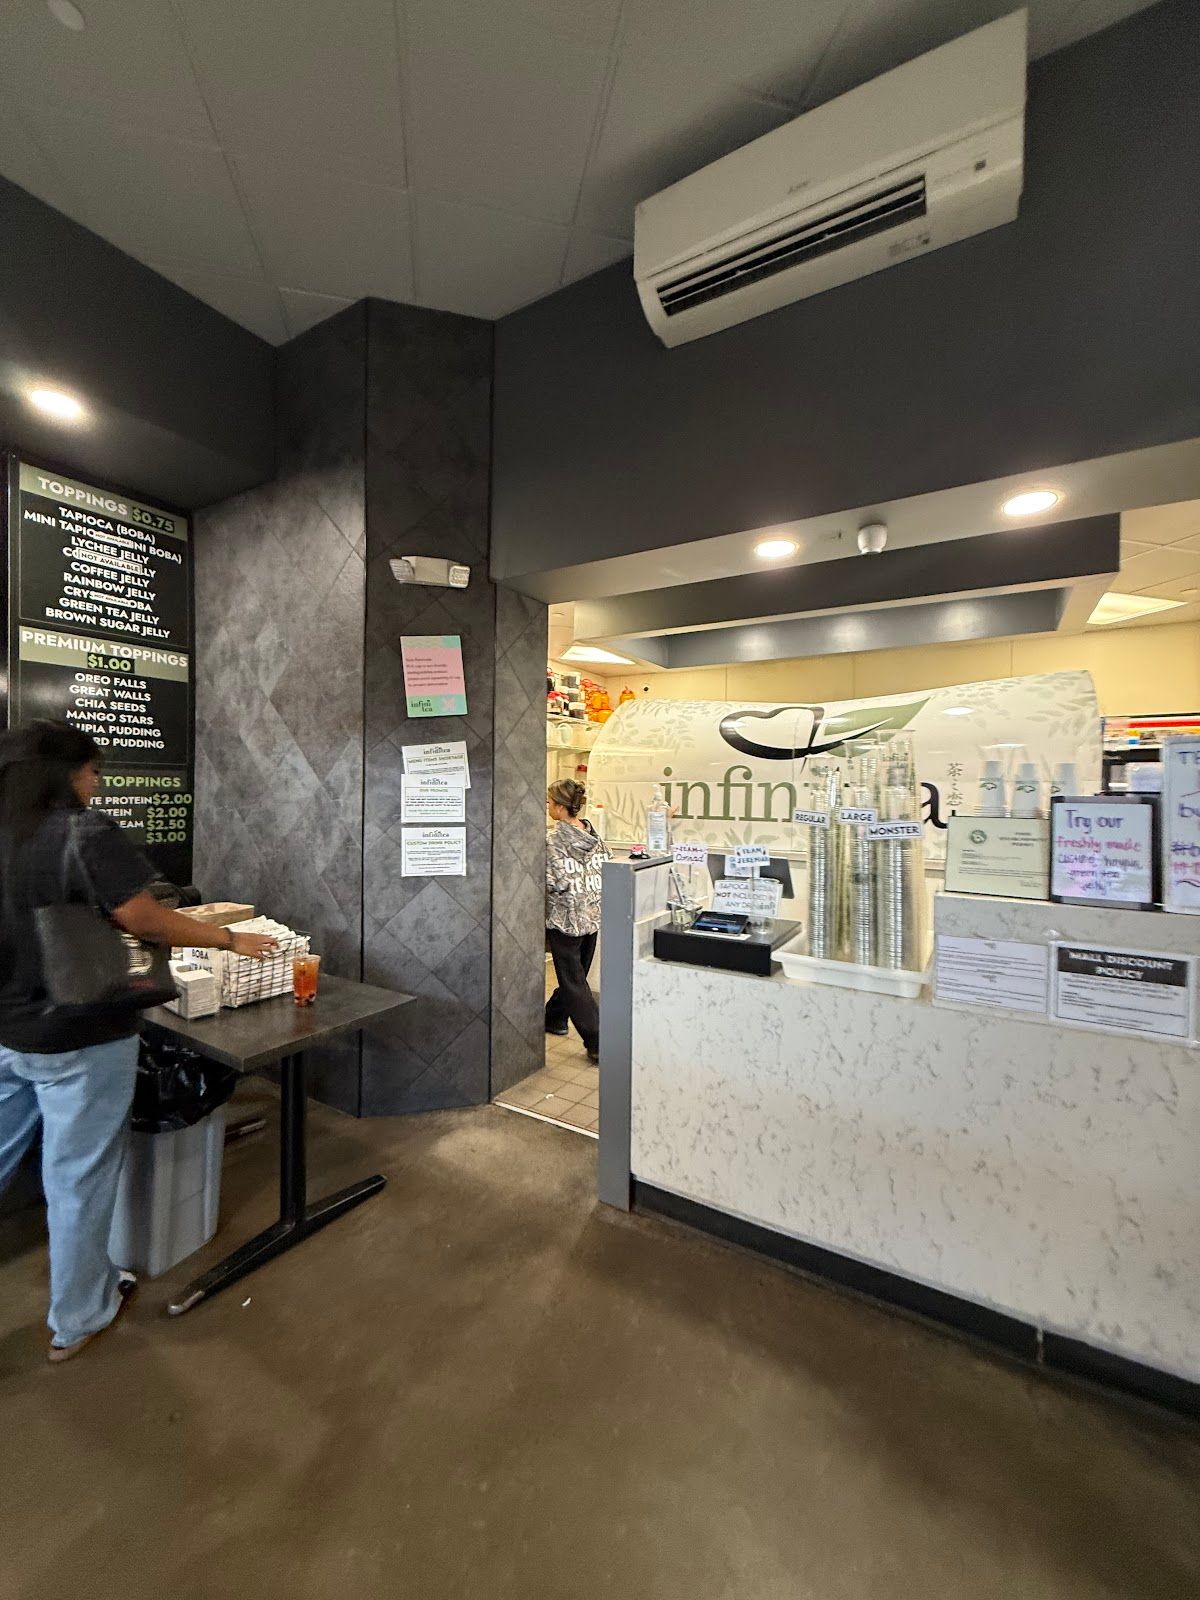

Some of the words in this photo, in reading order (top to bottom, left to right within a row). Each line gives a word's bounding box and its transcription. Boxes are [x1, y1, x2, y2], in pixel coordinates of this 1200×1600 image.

[38, 476, 128, 516] TOPPINGS
[131, 506, 175, 533] $0.75
[58, 506, 114, 532] TAPIOCA
[117, 523, 156, 545] (BOBA)
[23, 510, 56, 527] MINI
[58, 519, 97, 538] TAPIO
[149, 545, 182, 564] BOBA)
[71, 535, 118, 556] LYCHEE
[119, 549, 150, 565] JELLY
[81, 552, 98, 562] NOT
[101, 558, 139, 572] AVAILABLE
[70, 561, 118, 581] COFFEE
[119, 573, 150, 588] JELLY
[63, 572, 125, 593] RAINBOW
[126, 587, 157, 601] JELLY
[63, 585, 96, 600] CRYS
[128, 599, 153, 612] OBA
[58, 597, 103, 613] GREEN
[105, 605, 129, 619] TEA
[129, 611, 160, 625] JELLY
[45, 607, 97, 625] BROWN
[99, 616, 140, 633] SUGAR
[140, 624, 171, 639] JELLY
[21, 630, 106, 655] PREMIUM
[110, 644, 189, 668] TOPPINGS
[87, 653, 132, 672] $1.00
[75, 672, 111, 685] OREO
[114, 677, 147, 690] FALLS
[69, 684, 110, 698] GREAT
[114, 689, 151, 702] WALLS
[75, 698, 107, 710] CHIA
[110, 701, 147, 713] SEEDS
[66, 710, 117, 722] MANGO
[119, 714, 154, 726] STARS
[108, 725, 162, 738] PUDDING
[112, 737, 165, 749] PUDDING
[102, 775, 182, 788] TOPPINGS
[105, 796, 153, 805] PROTEIN
[153, 793, 192, 806] $2.00
[147, 806, 187, 819] $2.00
[794, 813, 827, 824] REGULAR
[840, 810, 873, 822] LARGE
[1065, 809, 1091, 834] Try
[1096, 816, 1124, 828] our
[146, 818, 186, 831] $2.50
[868, 825, 920, 836] MONSTER
[146, 831, 186, 844] $3.00
[1056, 835, 1102, 853] freshly
[1104, 838, 1142, 852] made
[191, 948, 209, 960] BOBA
[1104, 955, 1174, 971] DISCOUNT
[1095, 966, 1144, 979] POLICY
